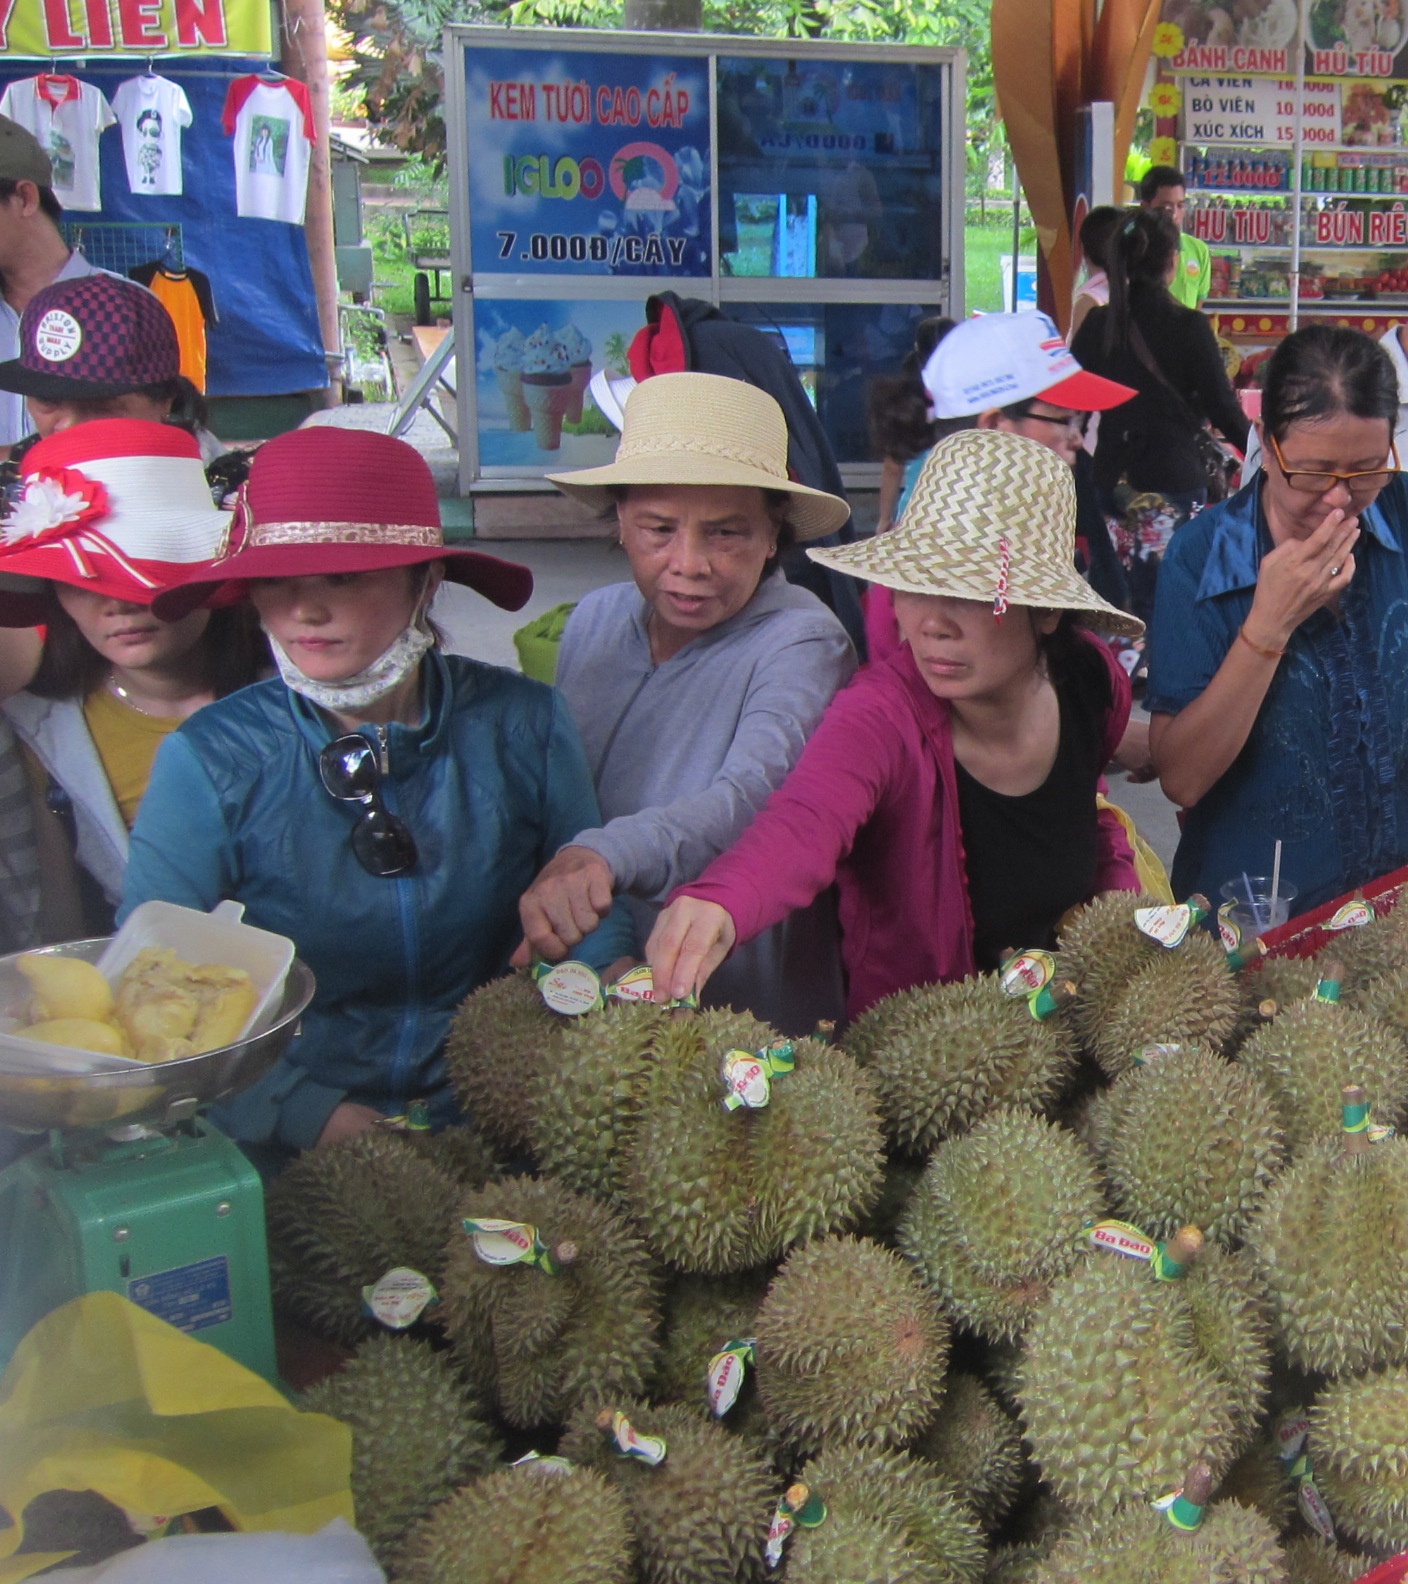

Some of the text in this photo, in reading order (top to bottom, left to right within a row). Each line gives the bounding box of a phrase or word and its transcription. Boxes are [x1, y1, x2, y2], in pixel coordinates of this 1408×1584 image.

[1234, 48, 1288, 72] CANH
[1315, 42, 1347, 75] HỦ
[489, 72, 690, 127] KEM TƯƠI CAO CẤP
[1192, 94, 1213, 113] BÒ
[1219, 97, 1255, 114] VIÊN
[1193, 120, 1224, 138] XÚC
[1230, 119, 1264, 139] XÍCH
[503, 154, 605, 200] IGLOO
[1233, 202, 1271, 243] TÍU
[1317, 200, 1364, 244] BÚN
[1095, 1230, 1116, 1244] Ba
